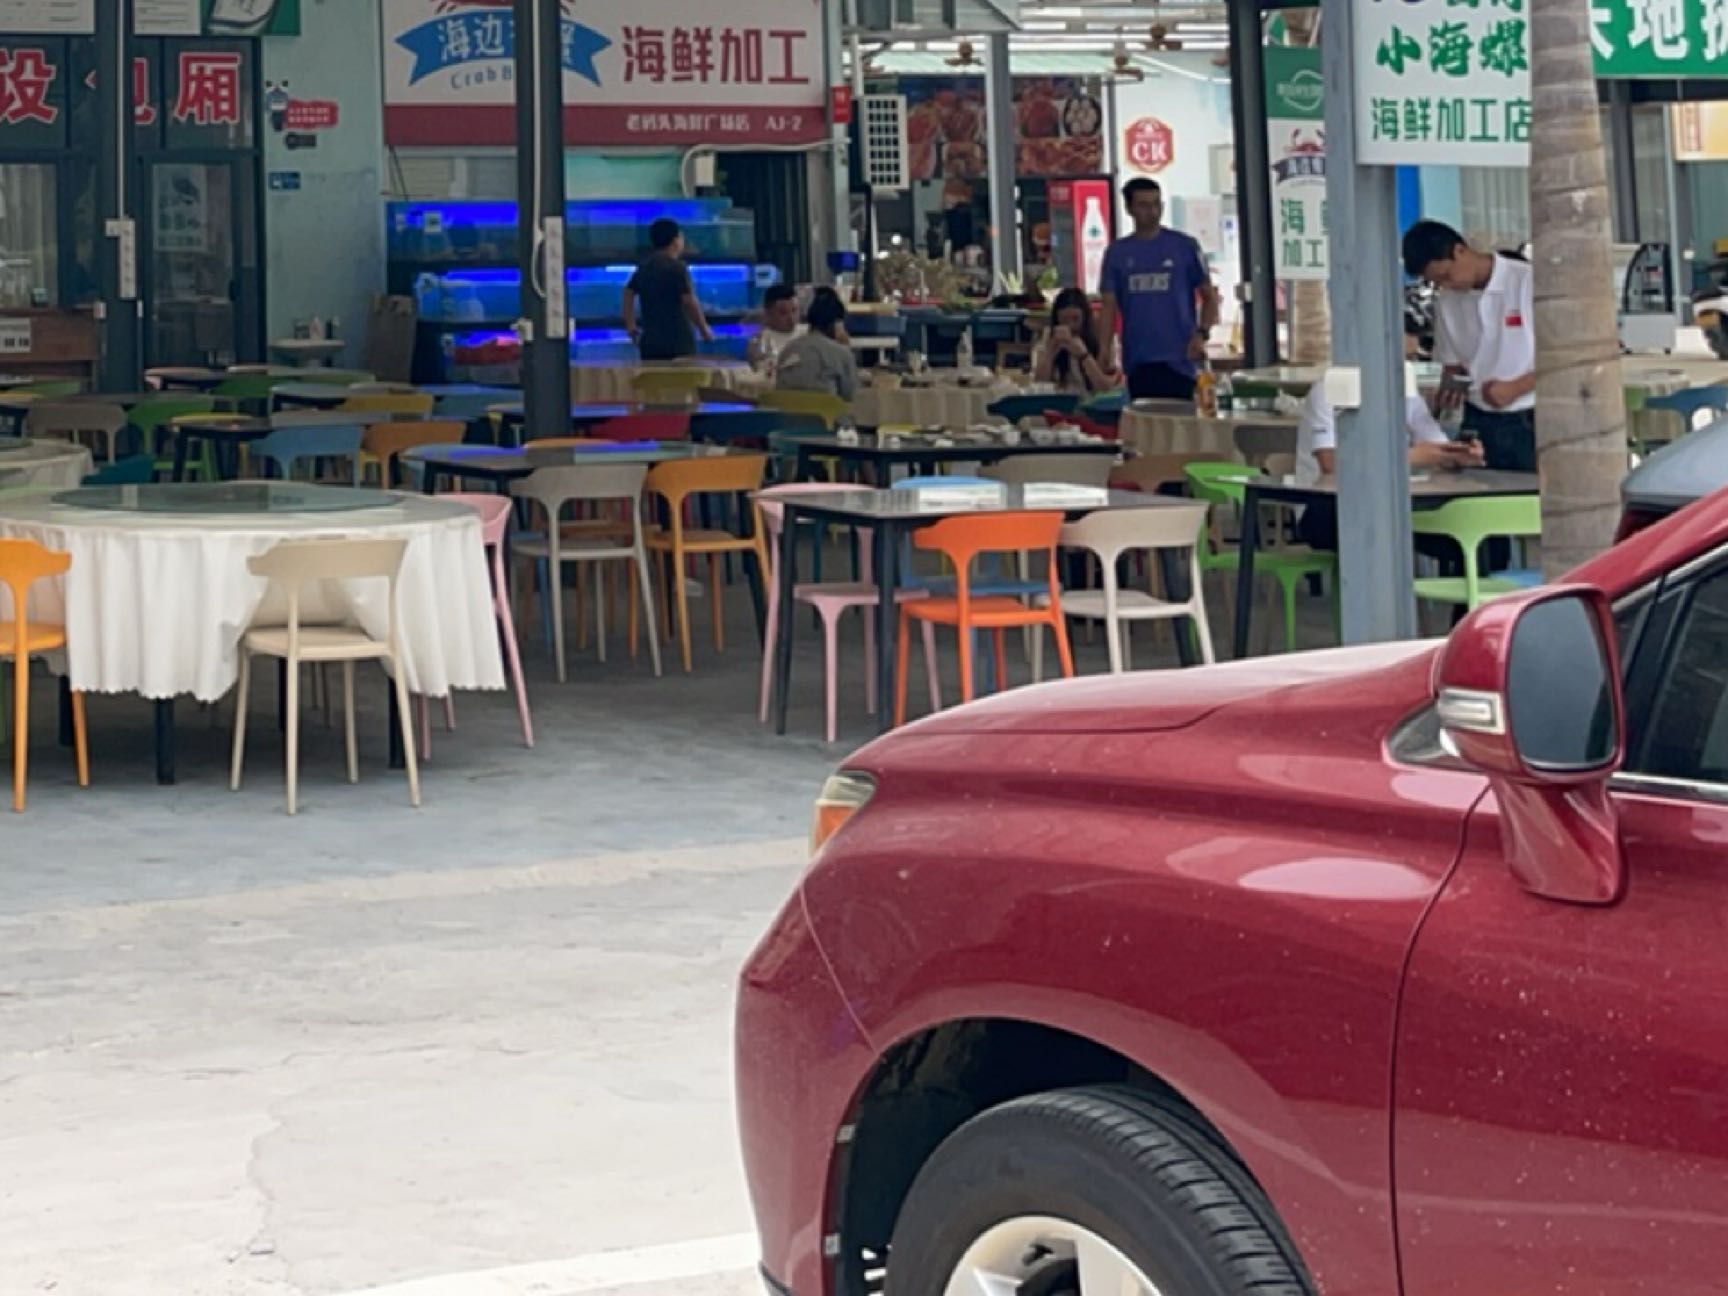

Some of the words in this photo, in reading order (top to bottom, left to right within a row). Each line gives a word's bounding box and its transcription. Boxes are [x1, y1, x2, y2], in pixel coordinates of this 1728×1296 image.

[622, 26, 811, 85] 海鲜加工
[1376, 17, 1529, 79] 小海螺
[1371, 96, 1533, 143] 海鲜加工店
